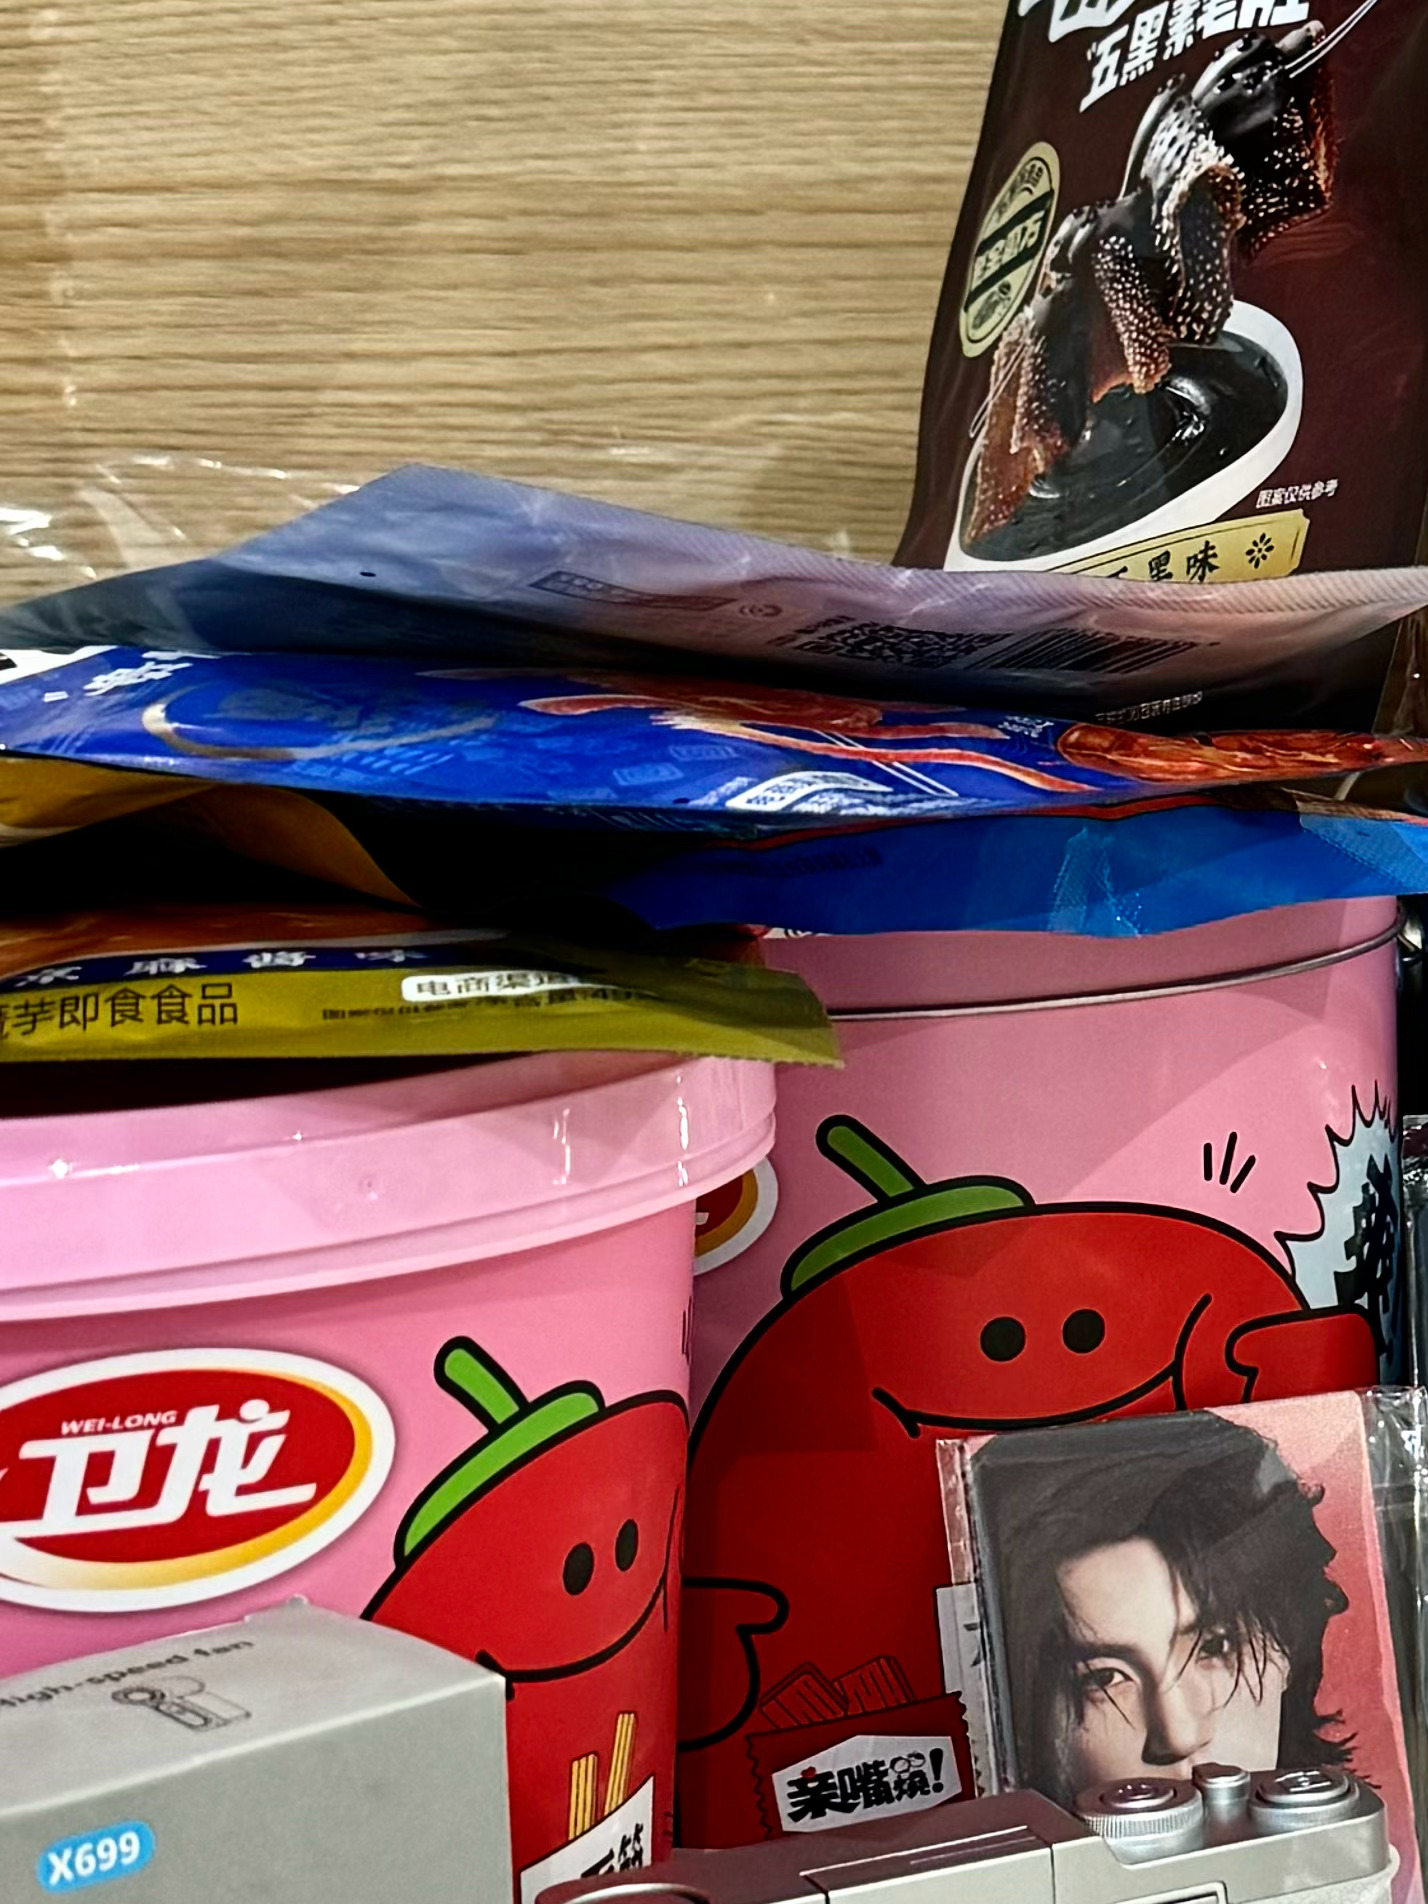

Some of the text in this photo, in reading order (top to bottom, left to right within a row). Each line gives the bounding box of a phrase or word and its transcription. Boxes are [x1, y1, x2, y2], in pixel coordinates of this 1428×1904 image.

[60, 1409, 178, 1436] WEI-LONG
[12, 1399, 318, 1536] 卫龙
[47, 1830, 141, 1887] X699
